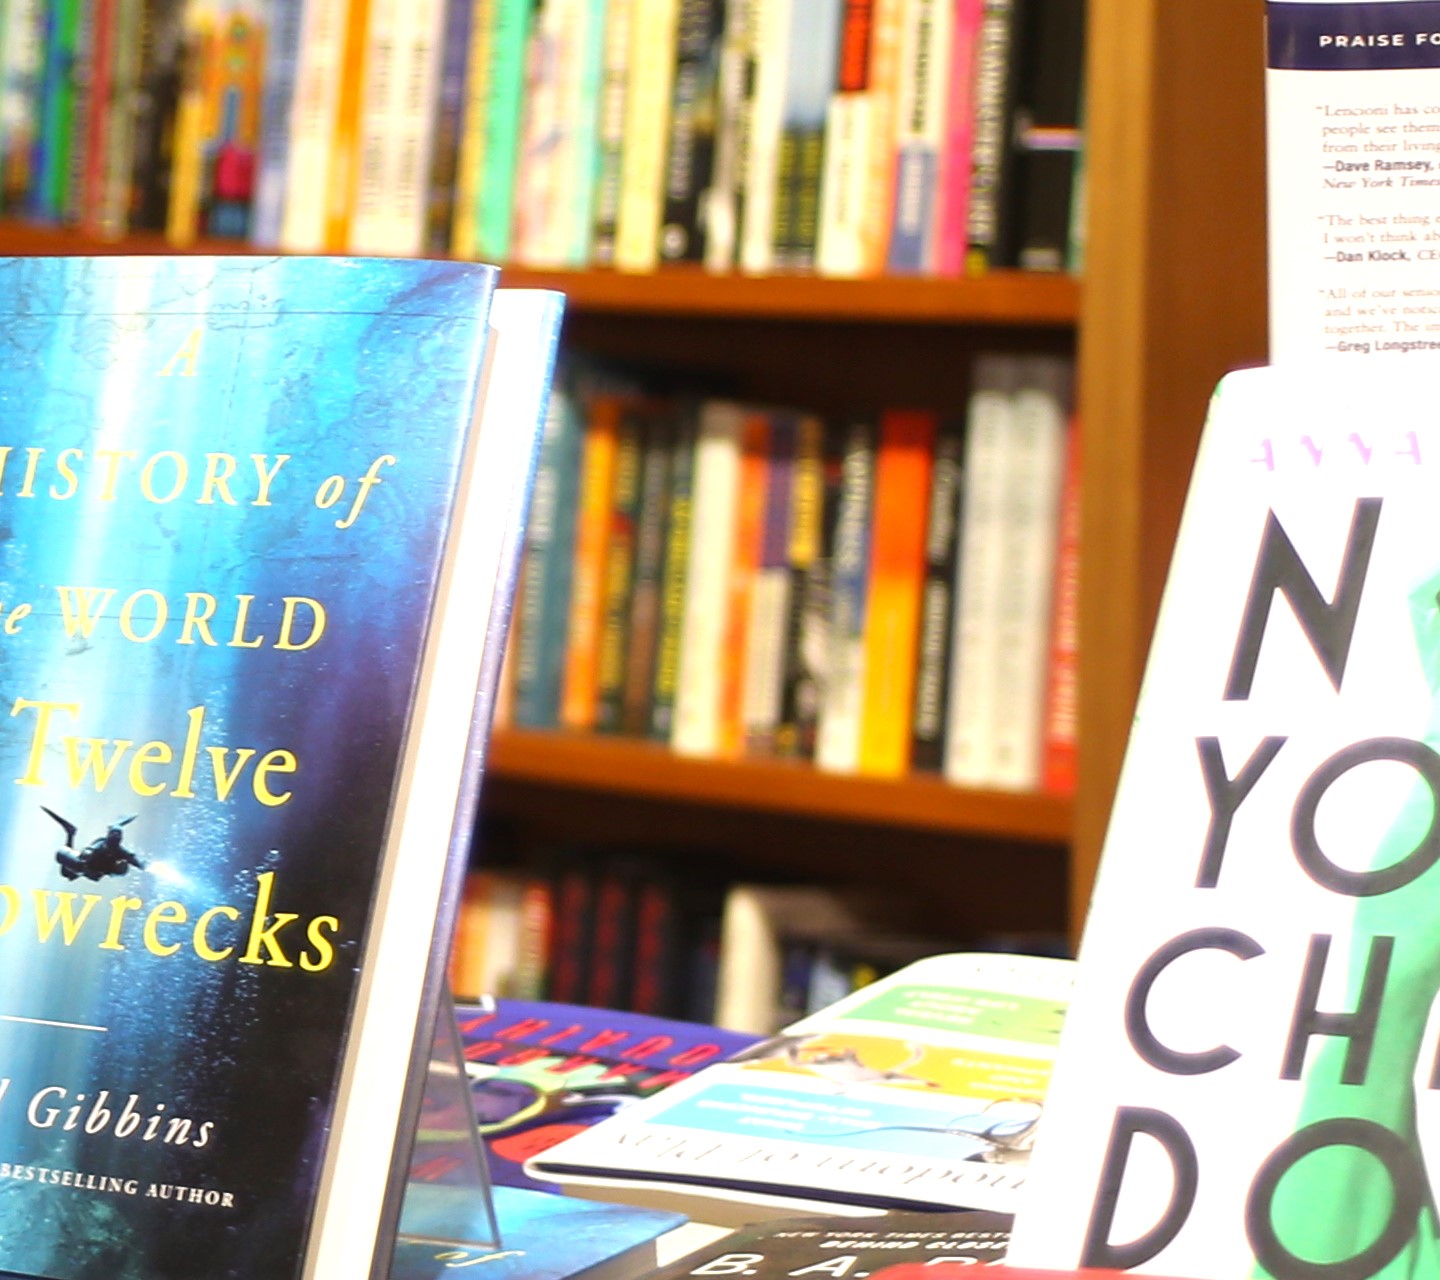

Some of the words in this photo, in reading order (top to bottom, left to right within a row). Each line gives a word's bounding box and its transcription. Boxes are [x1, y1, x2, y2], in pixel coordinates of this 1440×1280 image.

[1319, 34, 1405, 48] PRAISE
[156, 326, 206, 378] A
[1248, 429, 1423, 472] ANNA
[314, 453, 396, 530] of
[54, 585, 328, 652] WORLD
[10, 696, 298, 809] Twelve
[26, 1085, 216, 1151] Gibbins
[146, 1179, 236, 1211] AUTHOR
[690, 1252, 760, 1278] B.
[788, 1254, 871, 1279] A.
[819, 1240, 922, 1250] BEHIND
